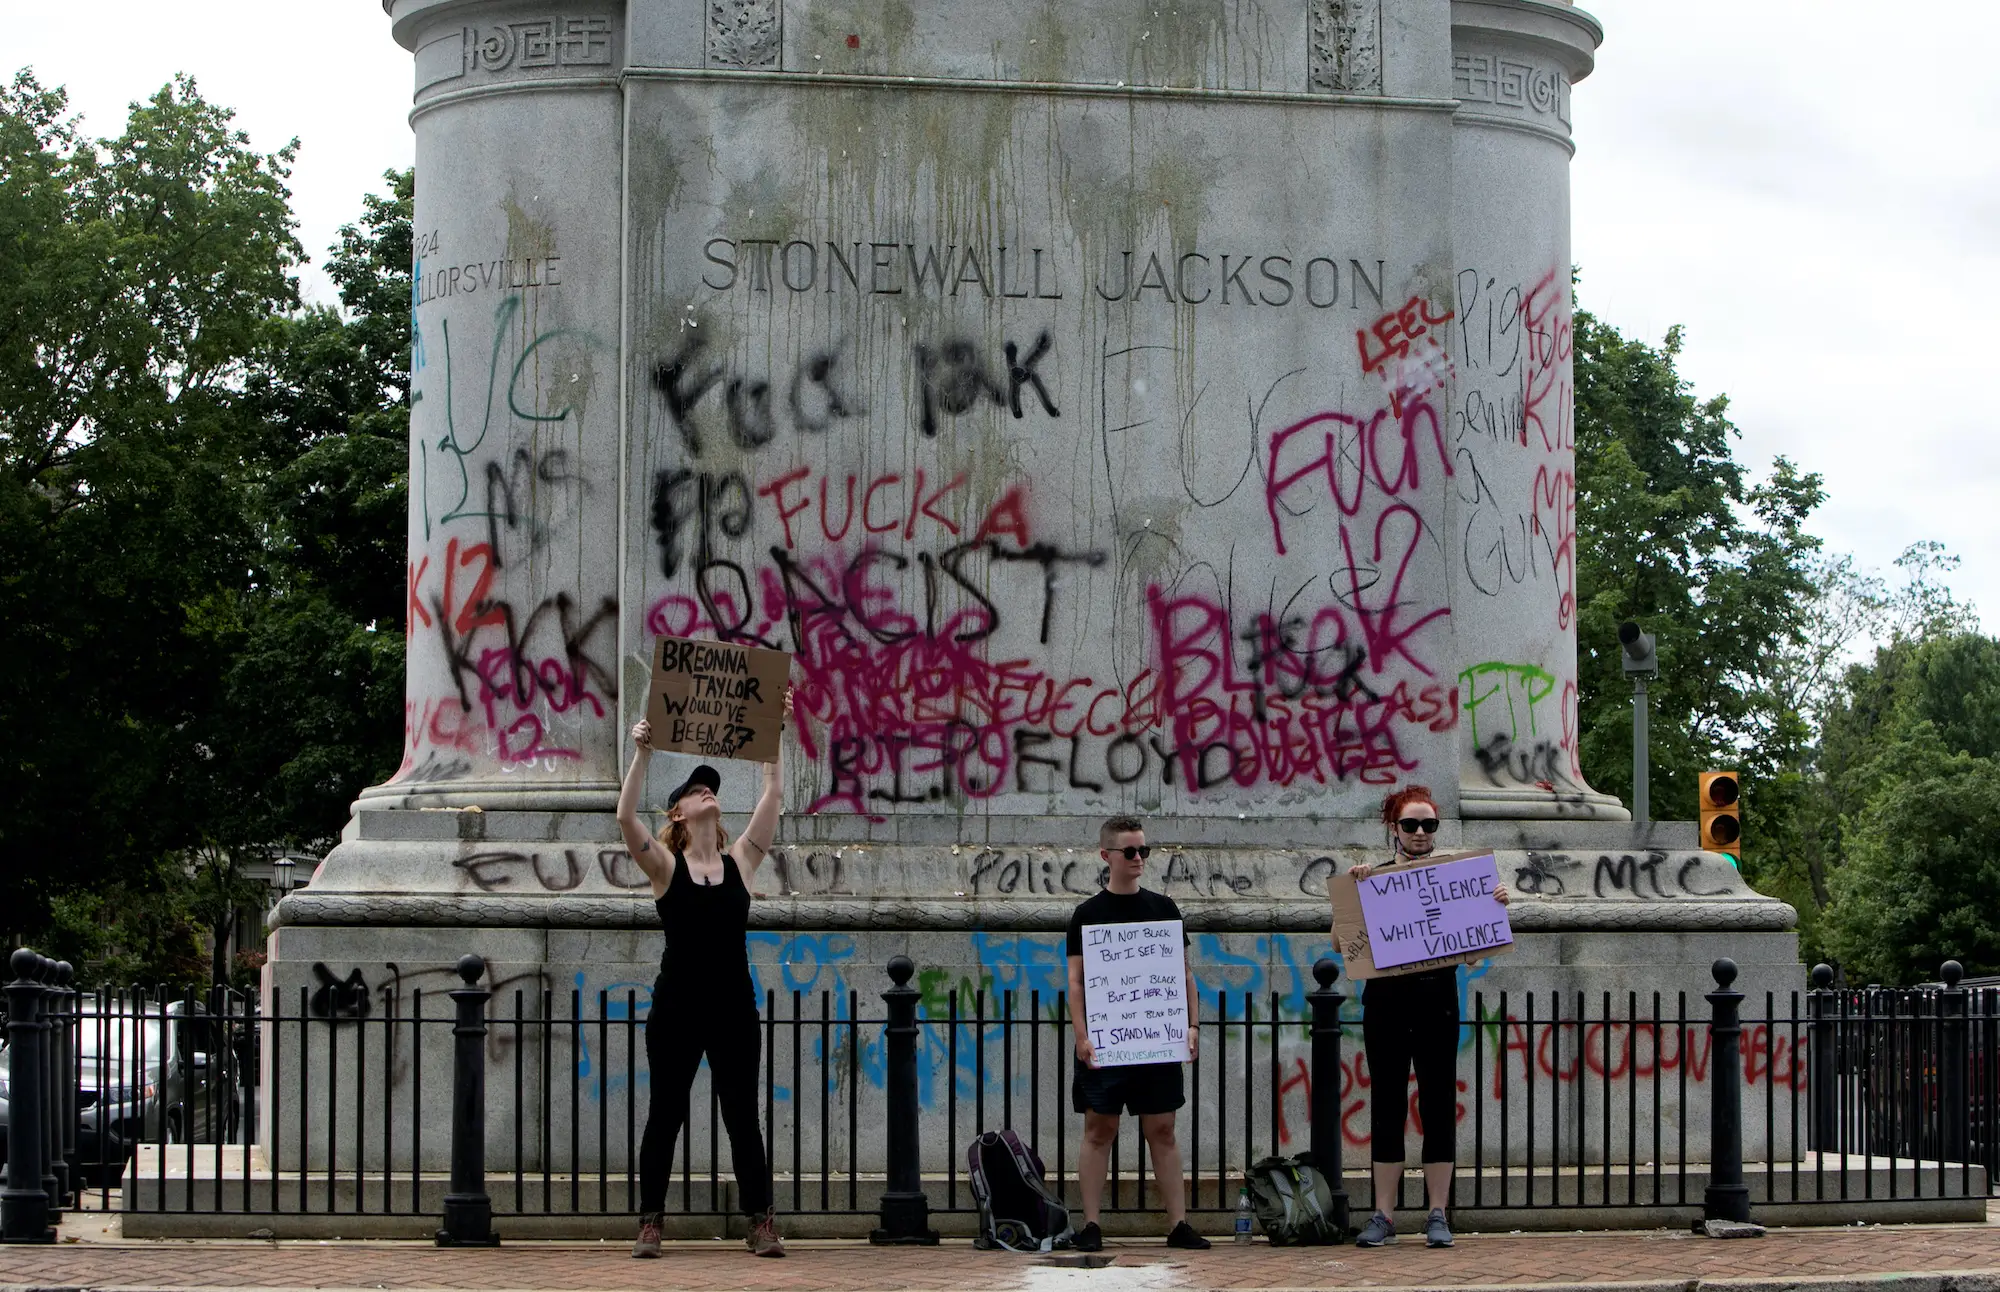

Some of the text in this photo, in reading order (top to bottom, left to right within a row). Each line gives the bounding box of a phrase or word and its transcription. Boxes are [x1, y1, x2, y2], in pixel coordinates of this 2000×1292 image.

[702, 238, 1385, 309] STONEWALL JACKSON
[662, 640, 748, 675] BREONNA
[692, 674, 764, 703] TAYLOR
[662, 692, 748, 723] WOULD'VE
[671, 719, 756, 749] BEEN 27
[698, 741, 737, 759] TODAY
[1370, 868, 1439, 896] WHITE
[1418, 875, 1494, 906] SILENCE
[1088, 927, 1171, 946] I'M NOT BLACK
[1379, 917, 1443, 942] WHITE
[1424, 920, 1506, 956] VIOLENCE
[1124, 947, 1135, 960] I
[1137, 944, 1156, 957] SEE
[1347, 929, 1369, 963] #BLM
[1088, 974, 1176, 988] I'M NOT BLACK
[1129, 989, 1141, 1002] I
[1143, 988, 1162, 999] HEAR
[1089, 1012, 1108, 1023] I'M
[1121, 1012, 1137, 1020] NOT
[1091, 1029, 1106, 1050] I
[1110, 1027, 1143, 1045] STAND
